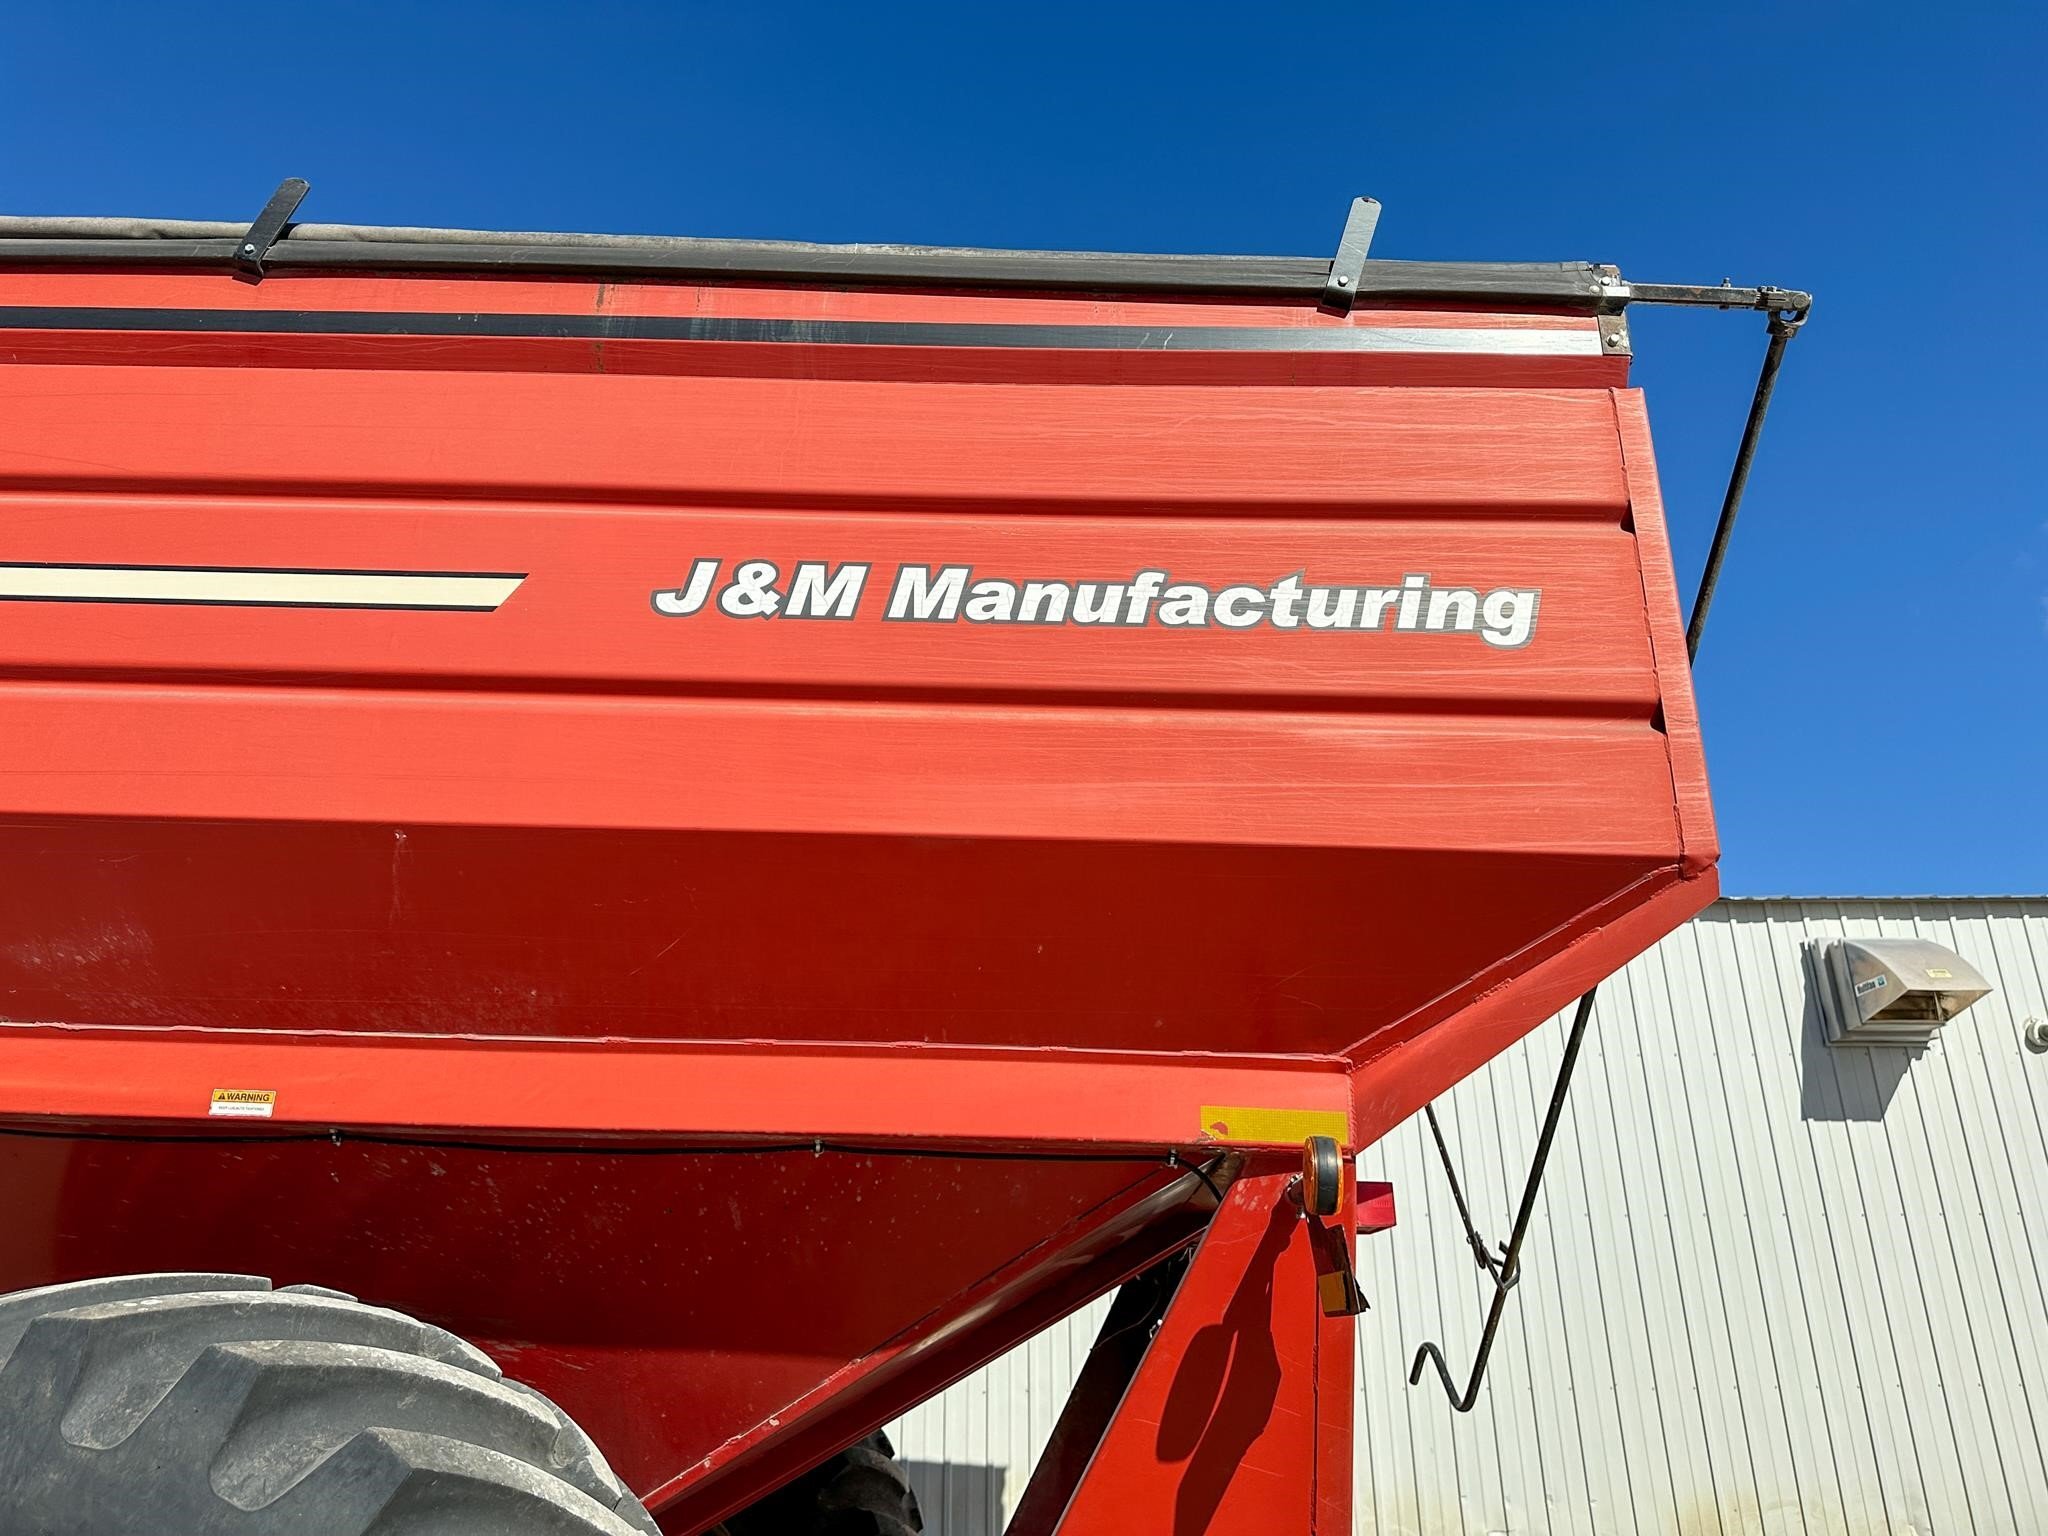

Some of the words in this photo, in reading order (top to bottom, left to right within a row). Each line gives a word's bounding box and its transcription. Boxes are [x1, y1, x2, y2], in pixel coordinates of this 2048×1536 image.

[652, 559, 870, 619] J&M
[884, 564, 1541, 648] Manufacturing
[226, 1092, 270, 1102] WARNING
